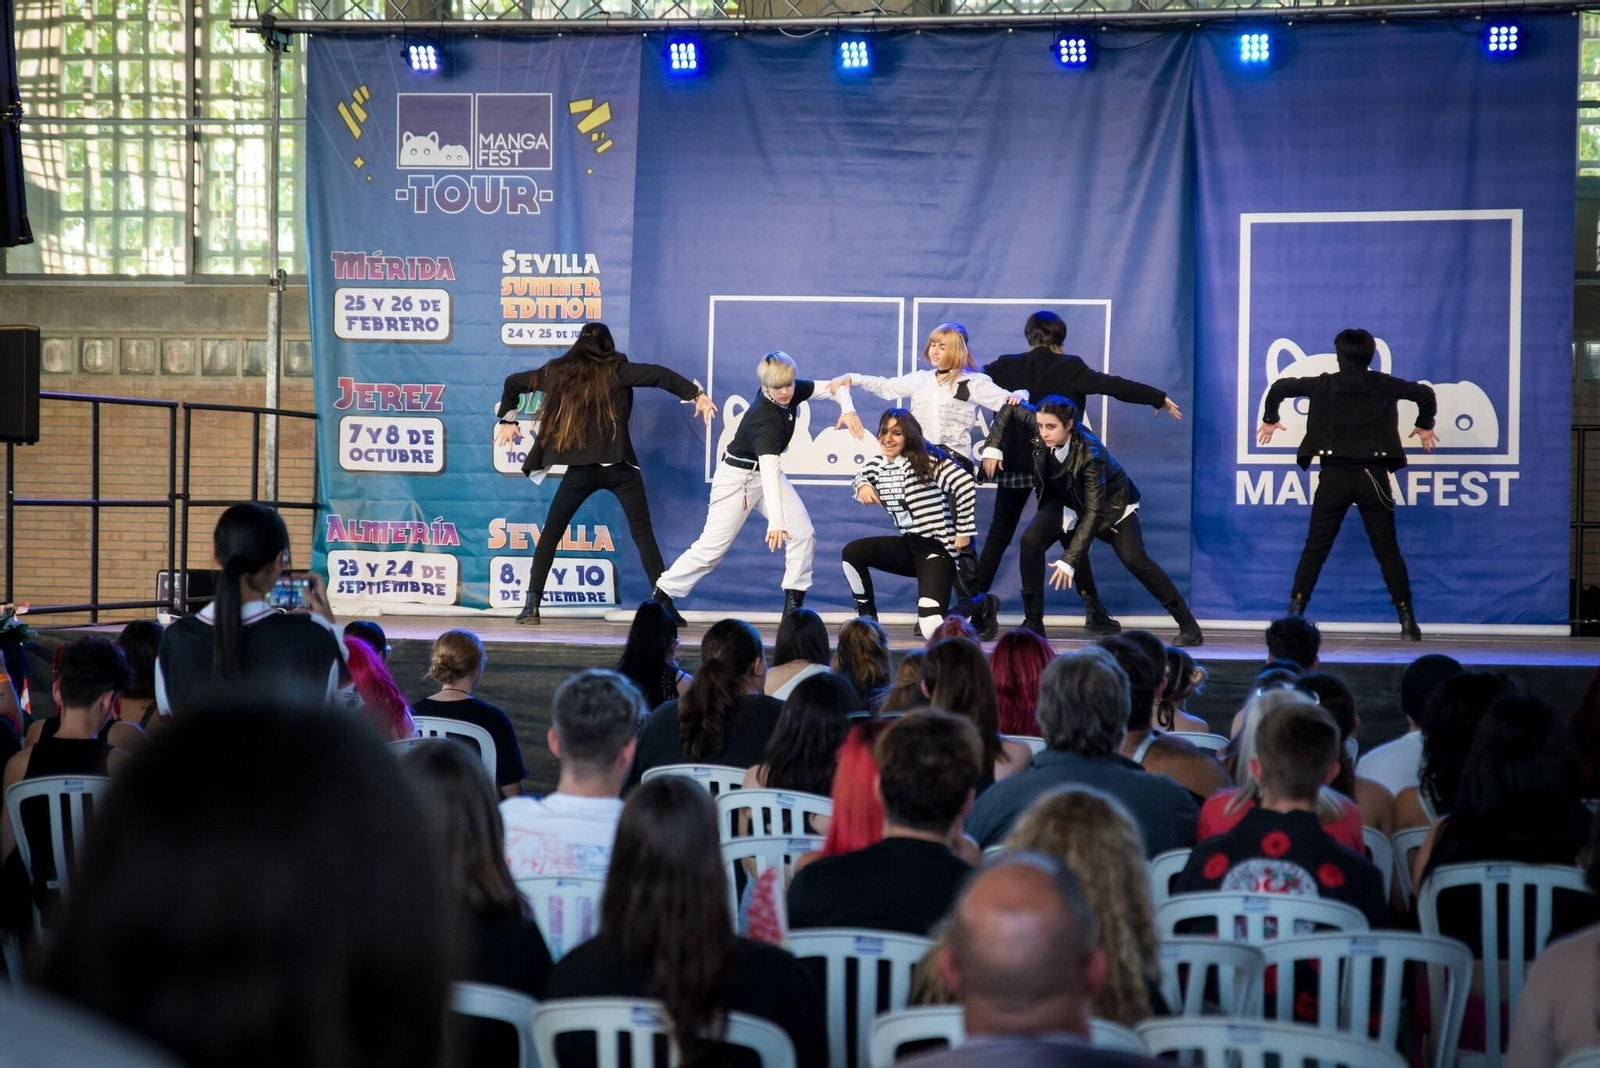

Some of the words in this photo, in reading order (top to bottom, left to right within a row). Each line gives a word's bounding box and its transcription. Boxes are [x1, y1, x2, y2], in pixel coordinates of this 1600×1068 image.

[478, 133, 549, 150] MANGA
[478, 150, 523, 166] FEST
[331, 250, 456, 281] MÉRIDA
[502, 249, 600, 274] SEVILLA
[501, 277, 601, 296] SUMMER
[344, 295, 366, 311] 25
[373, 299, 385, 311] Y
[391, 296, 413, 312] 26
[421, 299, 441, 312] DE
[501, 297, 601, 319] EDITION
[345, 315, 439, 332] FEBRERO
[507, 328, 524, 338] 24
[538, 328, 552, 339] 25
[556, 330, 568, 339] DE
[333, 377, 446, 412] JEREZ
[349, 424, 361, 444] 7
[366, 429, 381, 444] Y
[386, 424, 400, 445] 8
[407, 429, 434, 446] DE
[349, 448, 434, 464] OCTUBRE
[326, 514, 460, 547] ALMERÍA
[338, 559, 359, 577] 23
[366, 564, 379, 577] Y
[385, 560, 414, 578] 24
[421, 565, 446, 580] DE
[551, 568, 568, 586] Y
[576, 565, 605, 587] 10
[337, 581, 446, 597] SEPTIEMBRE
[500, 590, 521, 601] DE
